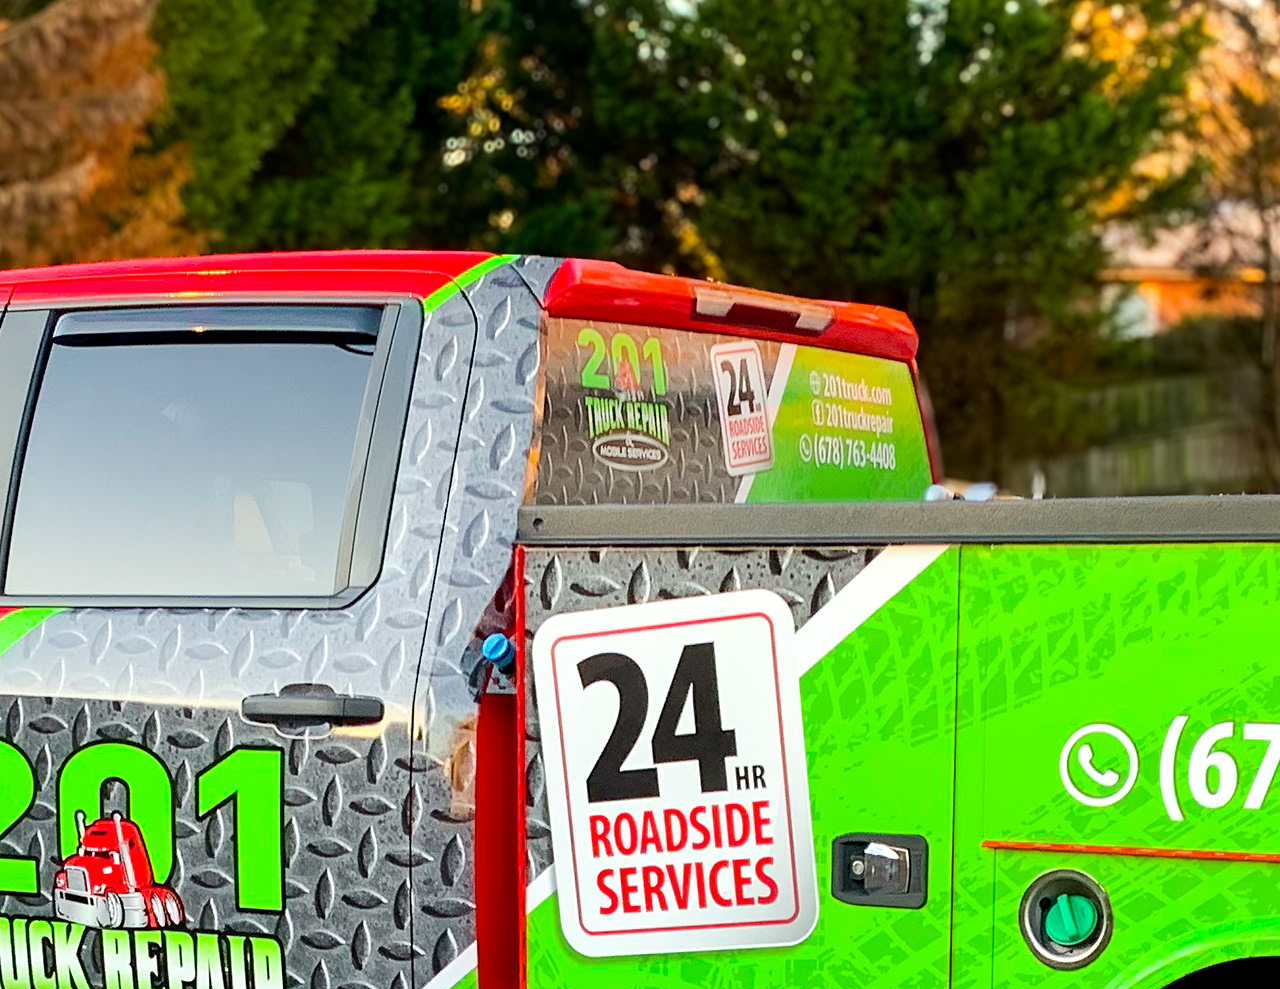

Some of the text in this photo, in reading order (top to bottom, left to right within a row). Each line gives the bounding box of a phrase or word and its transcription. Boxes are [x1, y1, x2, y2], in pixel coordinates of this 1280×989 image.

[578, 327, 667, 396] 201
[720, 358, 755, 416] 24
[822, 372, 893, 406] 201truck.com
[584, 395, 670, 448] TRUCK REPAIR
[728, 416, 765, 438] ROADSIDE
[825, 402, 894, 439] 201truckrepair
[731, 436, 768, 460] SERVICES
[813, 432, 896, 471] (678) 763-4408
[576, 641, 738, 804] 24
[735, 764, 767, 791] HR
[588, 800, 774, 858] ROADSIDE
[595, 856, 779, 915] SERVICES
